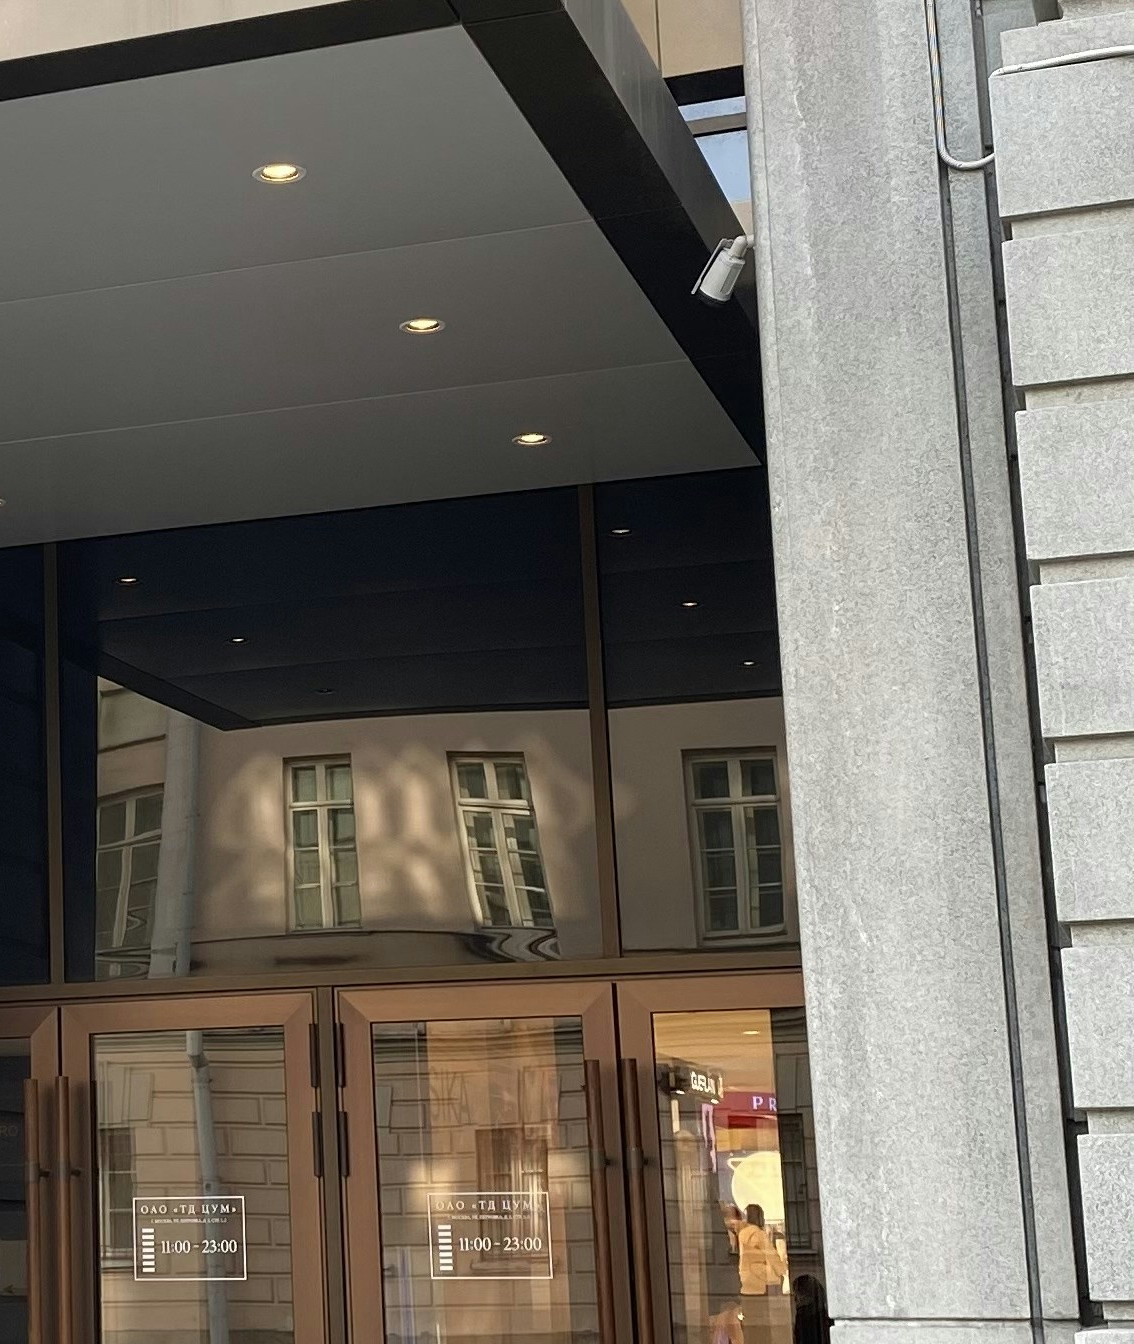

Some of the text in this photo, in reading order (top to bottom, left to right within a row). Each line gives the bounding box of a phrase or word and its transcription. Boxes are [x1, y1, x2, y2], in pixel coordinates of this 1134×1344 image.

[140, 1204, 168, 1215] ОАО
[201, 1204, 237, 1215] ЦУМ»
[435, 1200, 465, 1211] ОАО
[161, 1240, 191, 1254] 11:00
[201, 1239, 238, 1254] 23:00
[459, 1237, 492, 1251] 11:00
[503, 1237, 542, 1251] 23:00
